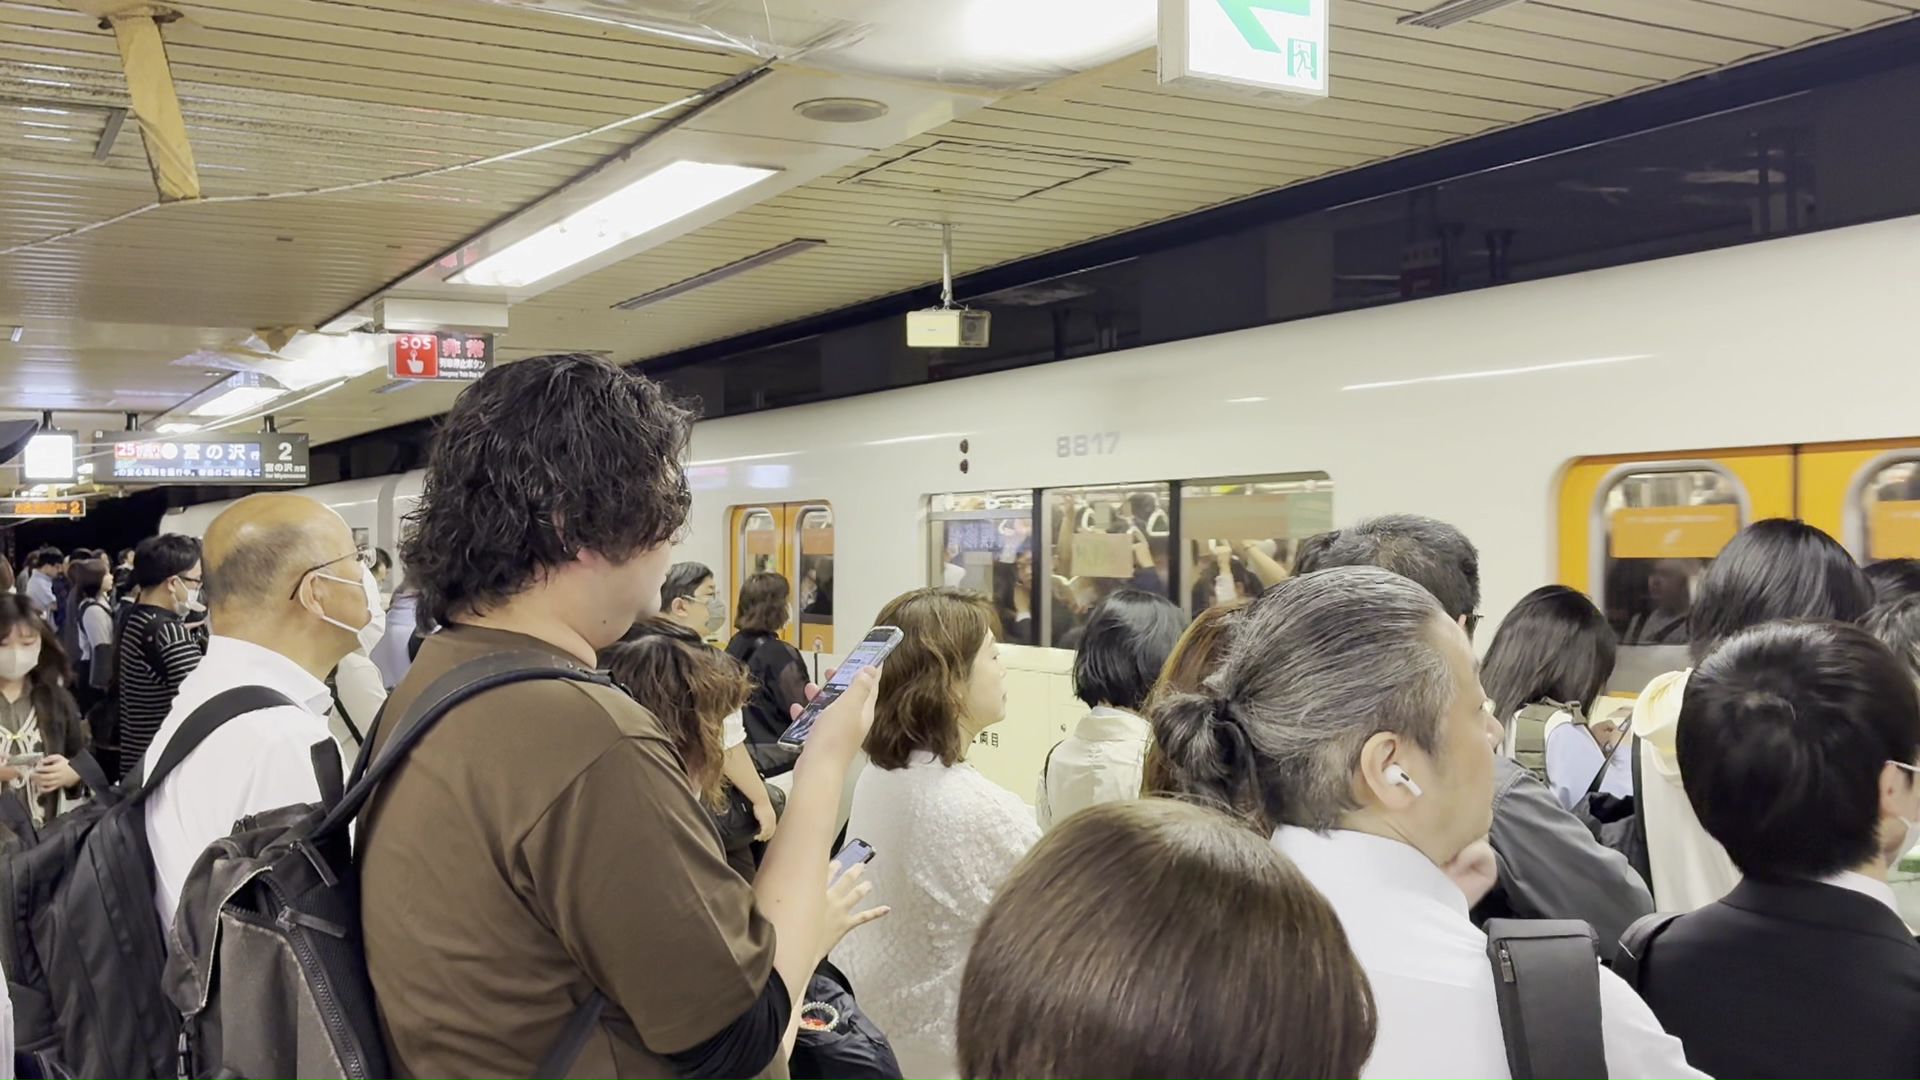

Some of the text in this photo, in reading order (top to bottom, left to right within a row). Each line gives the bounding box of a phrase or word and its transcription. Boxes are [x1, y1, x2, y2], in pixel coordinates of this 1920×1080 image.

[400, 337, 431, 350] SOS
[278, 442, 293, 460] 2
[70, 501, 80, 514] 2
